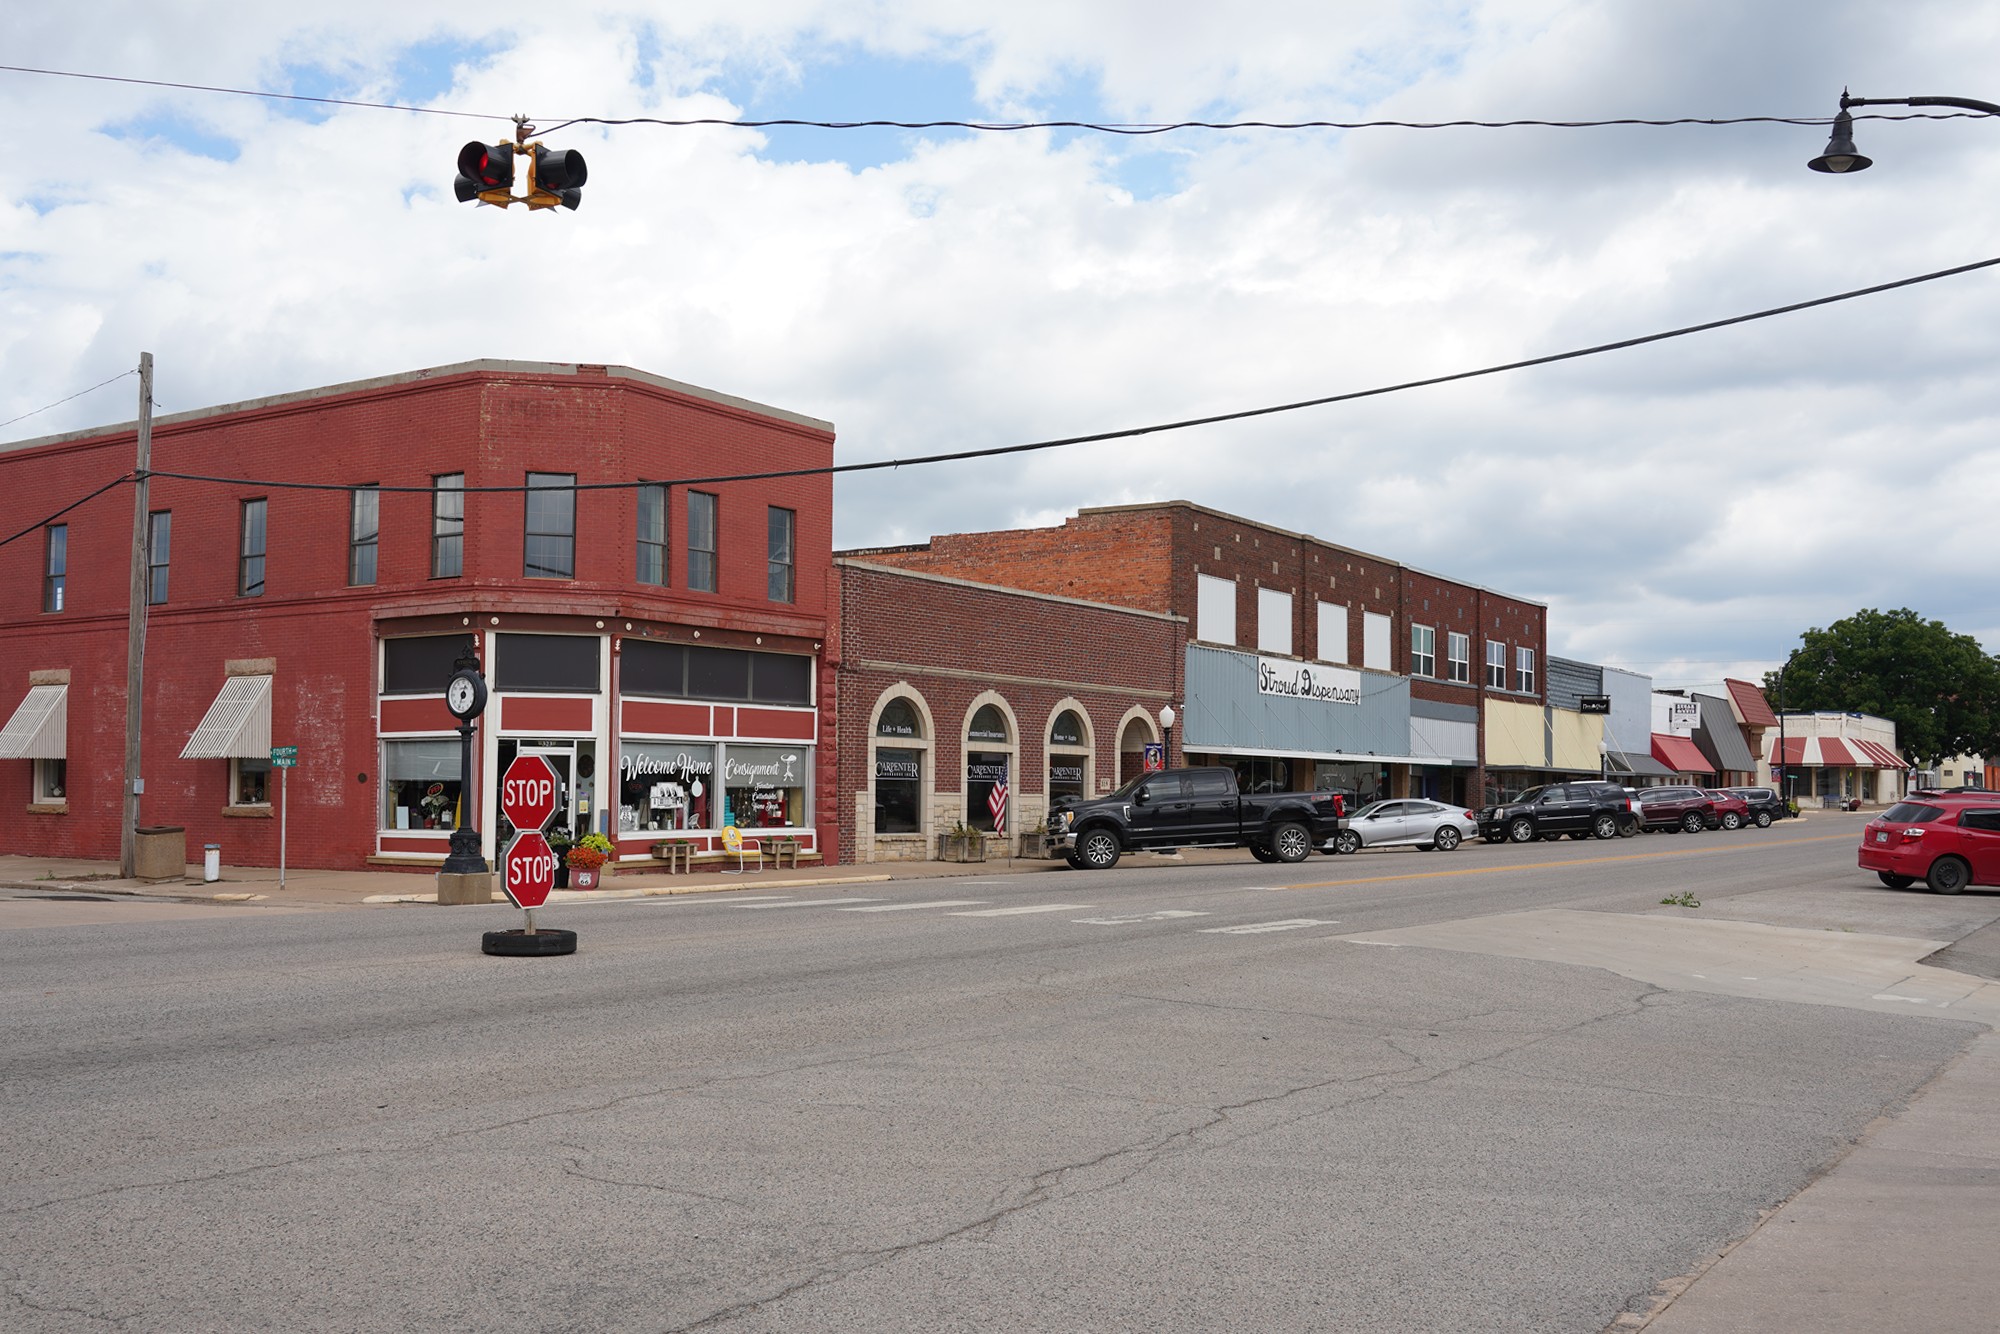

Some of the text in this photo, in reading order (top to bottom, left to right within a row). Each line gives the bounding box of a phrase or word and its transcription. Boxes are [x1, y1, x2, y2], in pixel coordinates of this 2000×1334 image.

[1260, 662, 1360, 704] Stroud Dispensary
[882, 725, 912, 734] Life Health
[1053, 733, 1065, 741] Home
[273, 747, 292, 756] FOURTH
[276, 758, 291, 766] MAIN
[620, 753, 713, 783] Welcome Home
[875, 761, 919, 778] CARPENTER
[725, 757, 780, 785] Consignment
[1050, 766, 1082, 781] CARPENTER
[505, 779, 551, 807] STOP
[510, 855, 551, 885] STOP
